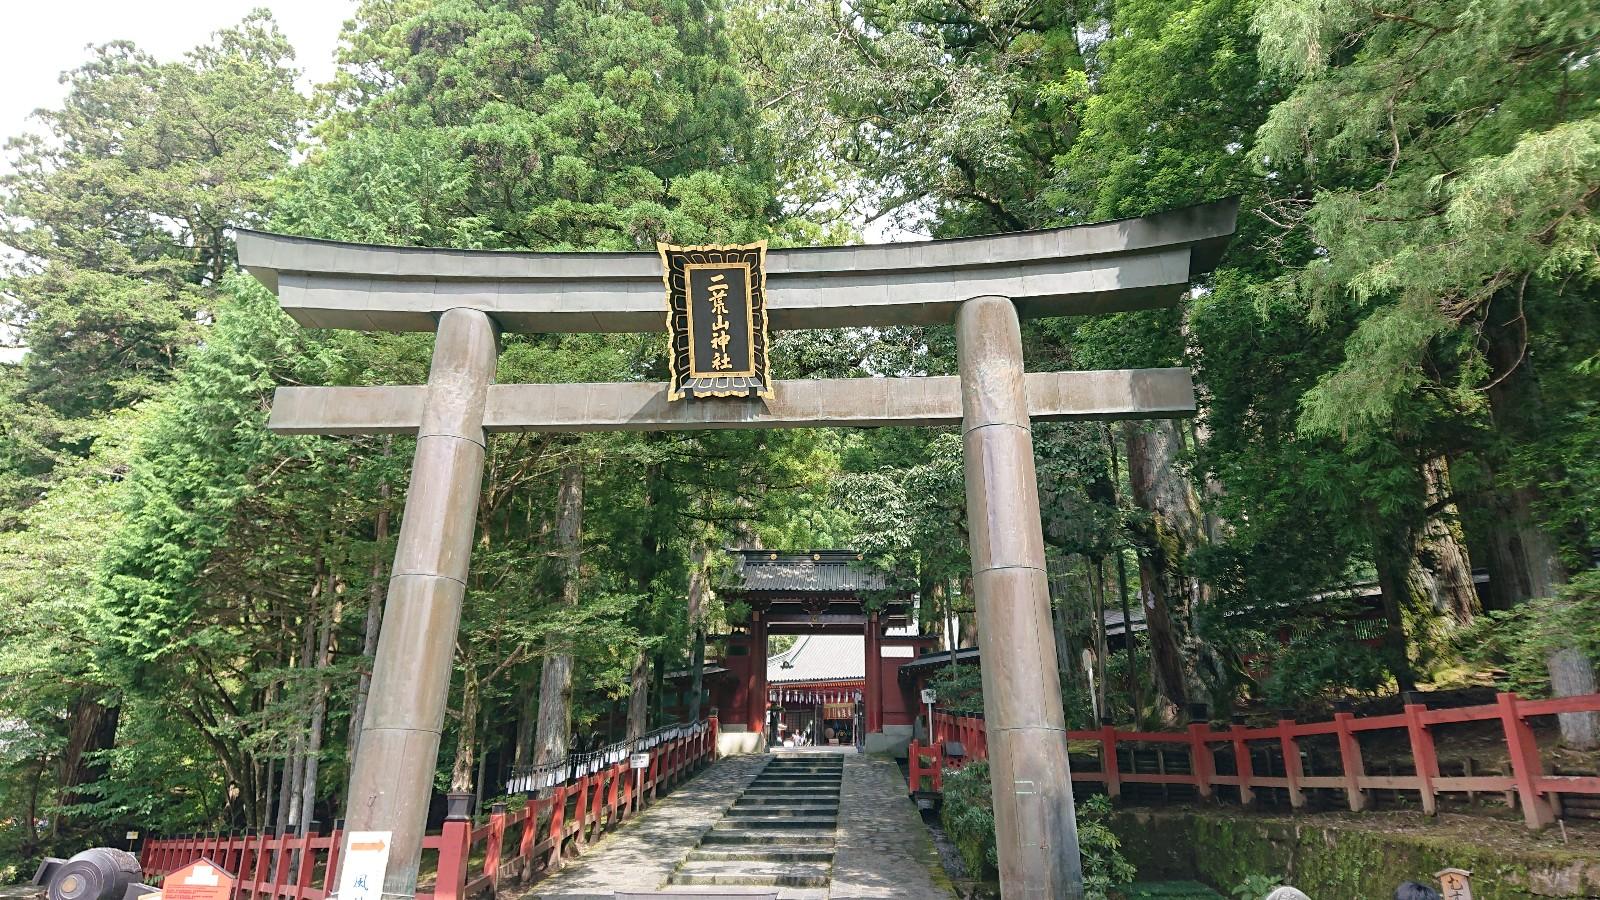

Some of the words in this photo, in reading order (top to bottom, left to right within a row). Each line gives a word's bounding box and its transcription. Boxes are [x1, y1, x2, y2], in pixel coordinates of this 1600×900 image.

[708, 274, 732, 370] 二荒山神社
